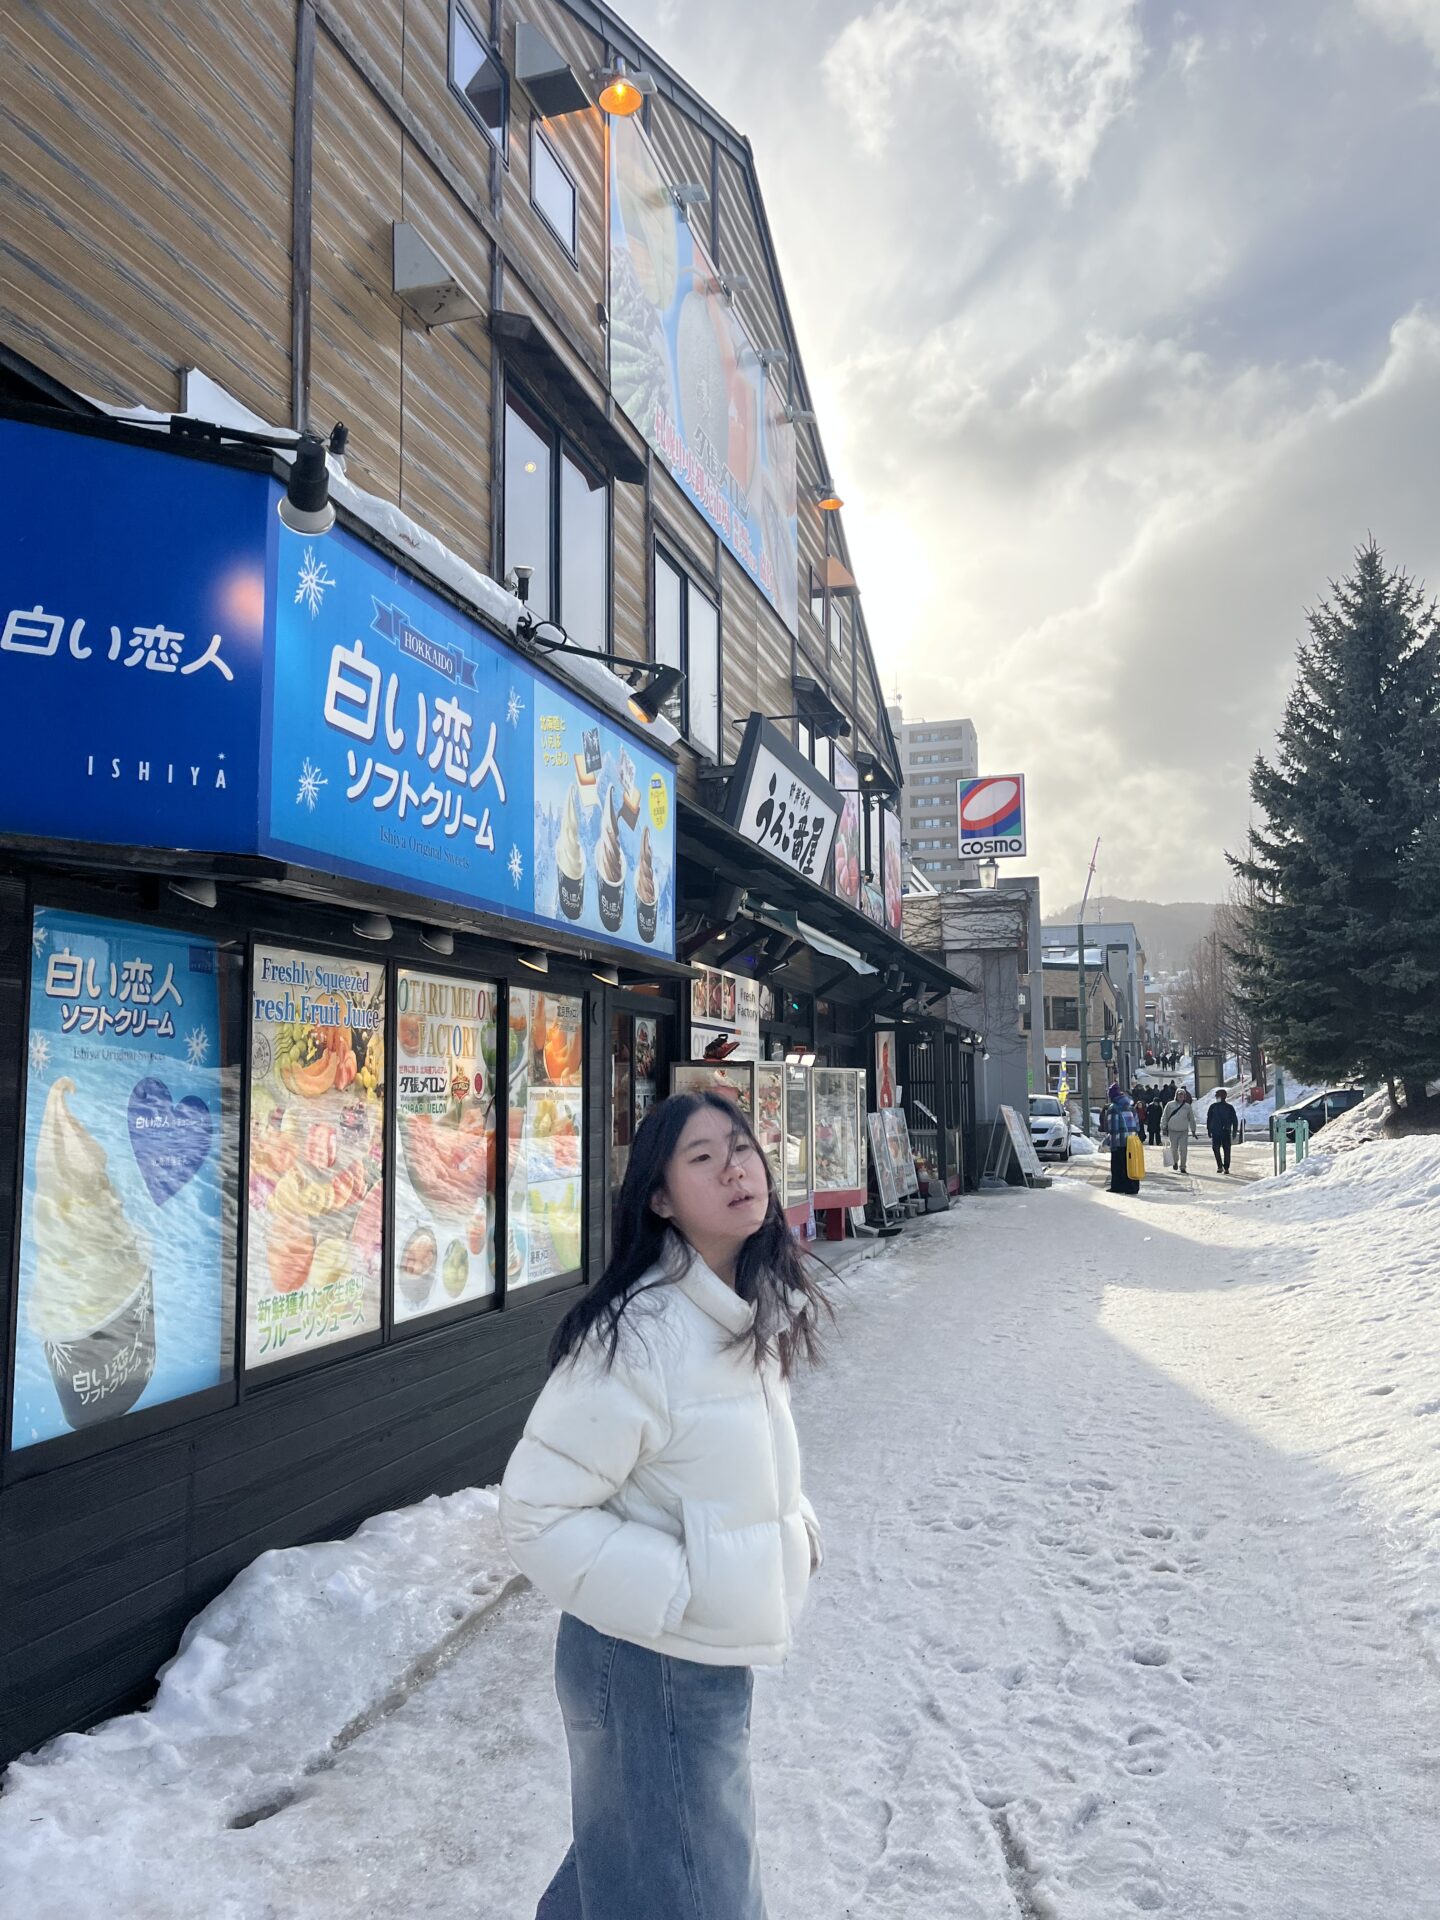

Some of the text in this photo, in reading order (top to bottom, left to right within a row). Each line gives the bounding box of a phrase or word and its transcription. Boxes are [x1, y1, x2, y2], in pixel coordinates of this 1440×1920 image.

[0, 605, 234, 681] 白い恋人
[404, 631, 454, 675] HOKKAIDO
[323, 639, 507, 803] 白い恋人
[87, 755, 227, 789] ISHIYA
[346, 750, 496, 852] ソフトクリーム
[379, 825, 406, 849] Ishiya
[408, 835, 442, 861] Original
[45, 946, 183, 1006] 白い恋人
[261, 957, 369, 993] Freshly Squeezed
[252, 991, 379, 1030] resh Fruit Juice
[397, 978, 448, 1018] OTARU
[737, 1003, 758, 1024] Factory
[740, 987, 756, 1003] Fresh
[61, 1004, 175, 1037] ソフトクリーム
[417, 1021, 480, 1059] FACTORY
[399, 1076, 448, 1093] 夕張メロン
[135, 1115, 170, 1129] 白い恋人
[258, 1300, 366, 1355] フルーツジュース
[72, 1331, 144, 1393] 白い恋人
[80, 1358, 142, 1405] ソフトクリーム
